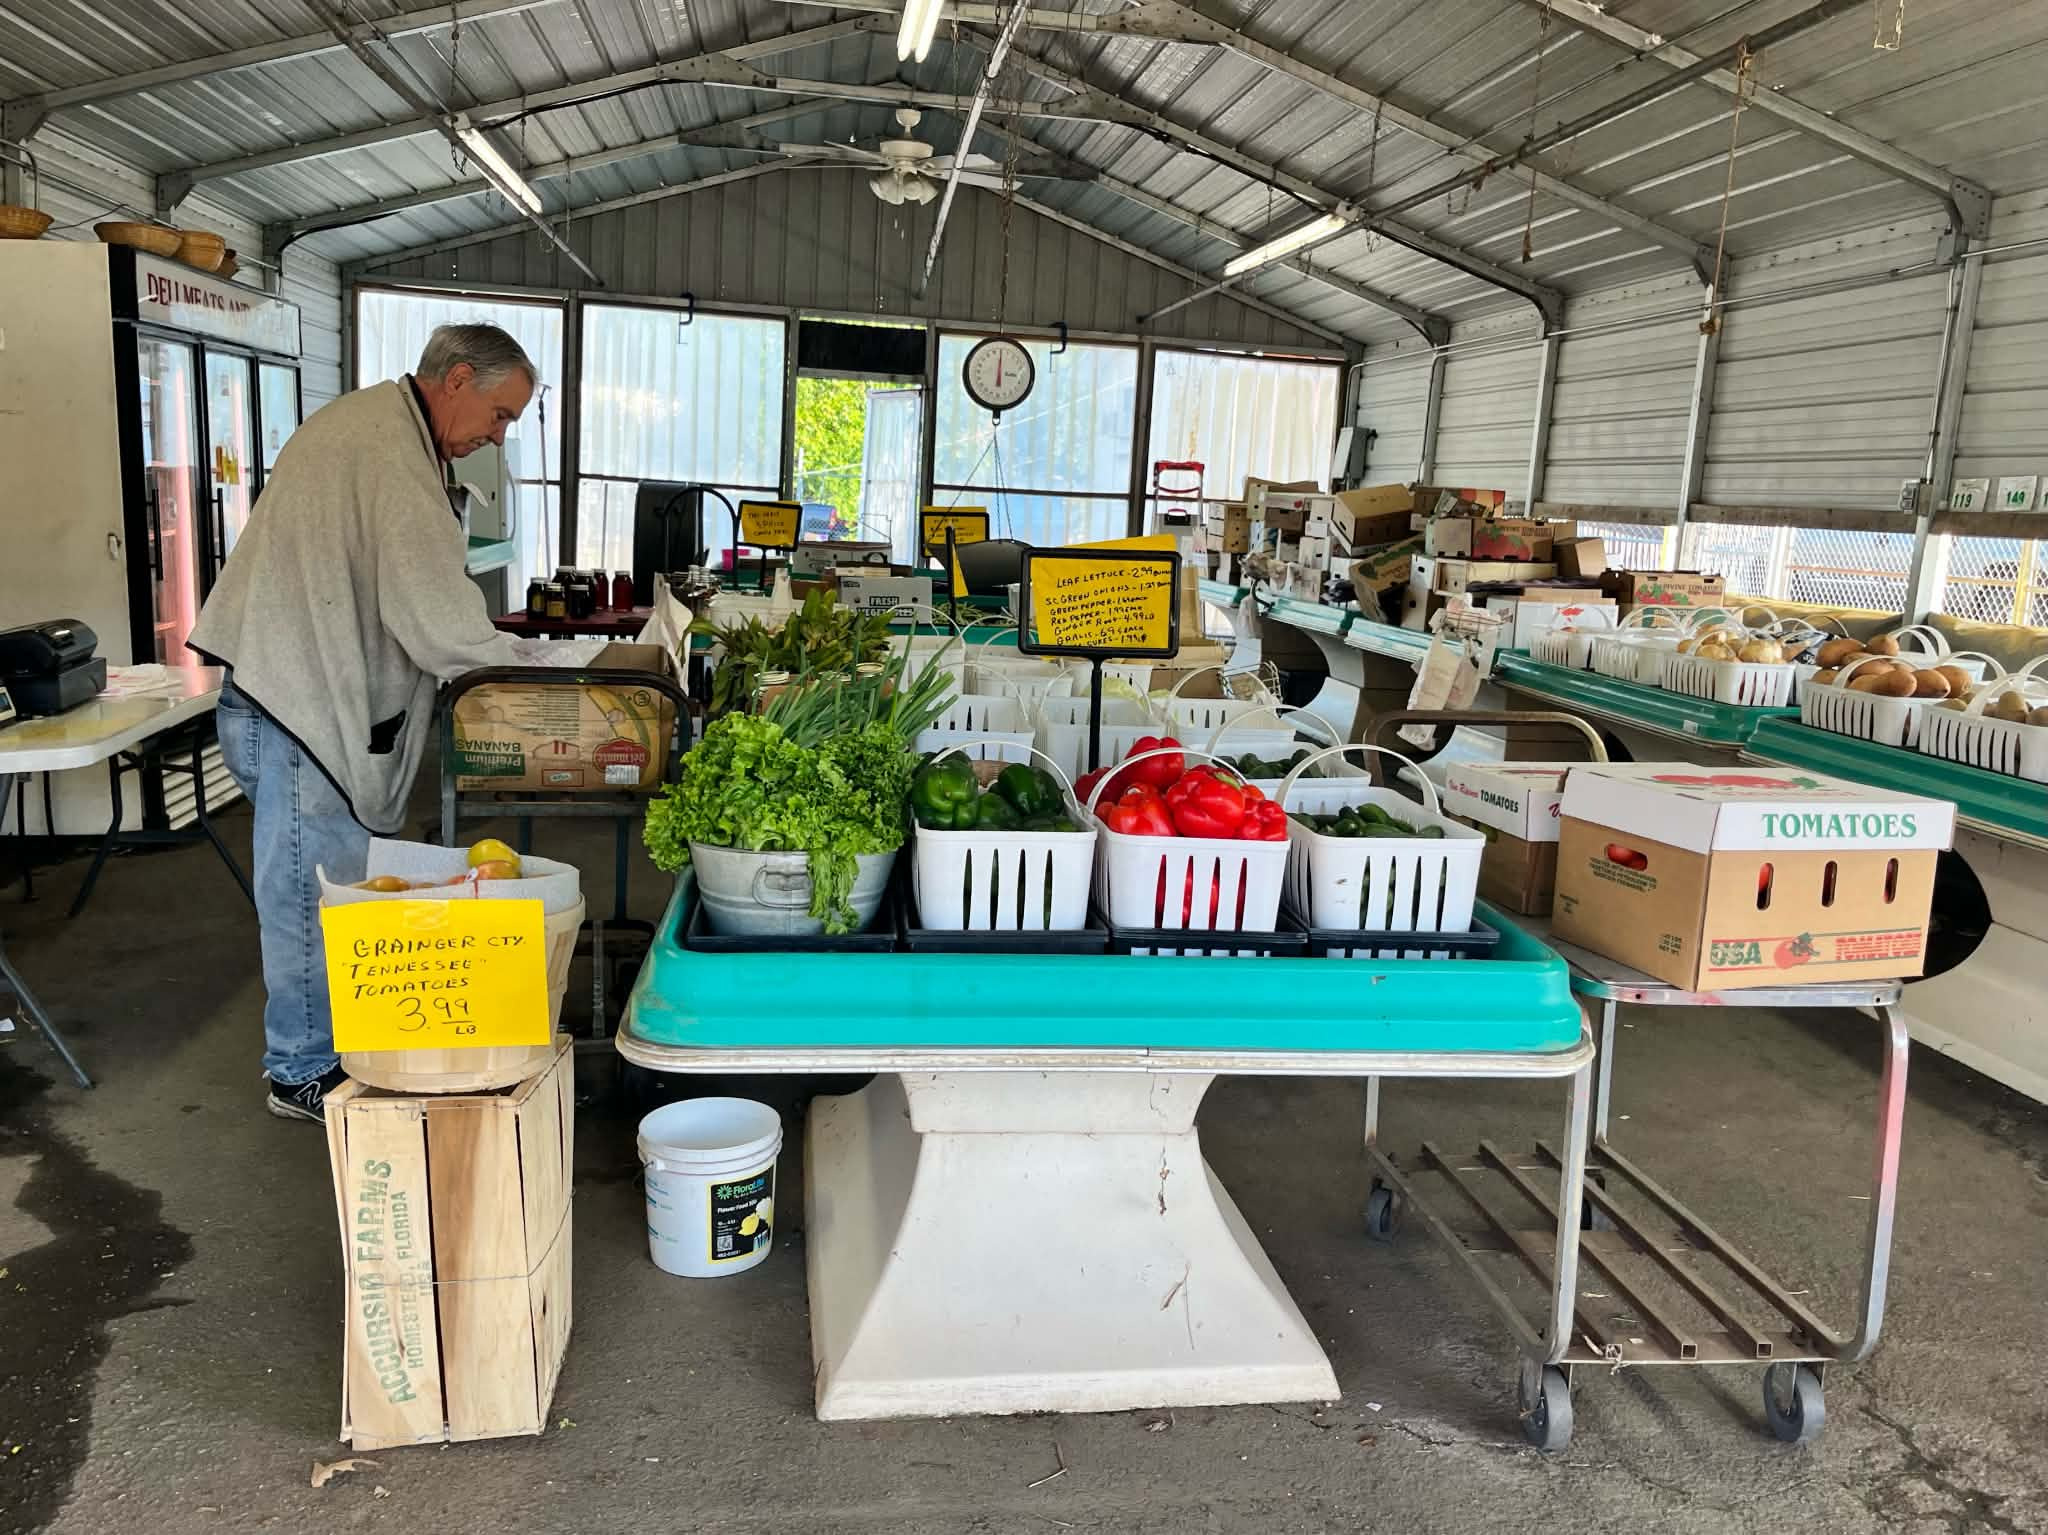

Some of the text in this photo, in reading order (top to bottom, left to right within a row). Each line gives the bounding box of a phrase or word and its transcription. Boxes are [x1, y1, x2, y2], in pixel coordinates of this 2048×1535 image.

[1954, 493, 1973, 508] 119
[1057, 576, 1080, 588] LEAF
[1083, 570, 1125, 583] LETTUCE
[870, 597, 899, 606] FRESH
[1060, 592, 1090, 604] GREEN
[1093, 584, 1130, 597] ONIONS
[1050, 604, 1079, 616] GREEN
[1051, 616, 1067, 627] RED
[456, 740, 521, 753] BANANAS
[465, 754, 521, 767] Premium
[1480, 789, 1519, 813] TOMATOES
[1762, 813, 1917, 838] TOMATOES
[353, 936, 476, 958] GRAINGER
[1711, 943, 1762, 967] USA
[354, 977, 470, 1000] TOMATOES
[396, 996, 471, 1032] 3.99
[456, 1025, 477, 1035] LB
[357, 1159, 392, 1262] FARMS
[391, 1191, 412, 1260] FLORIDA
